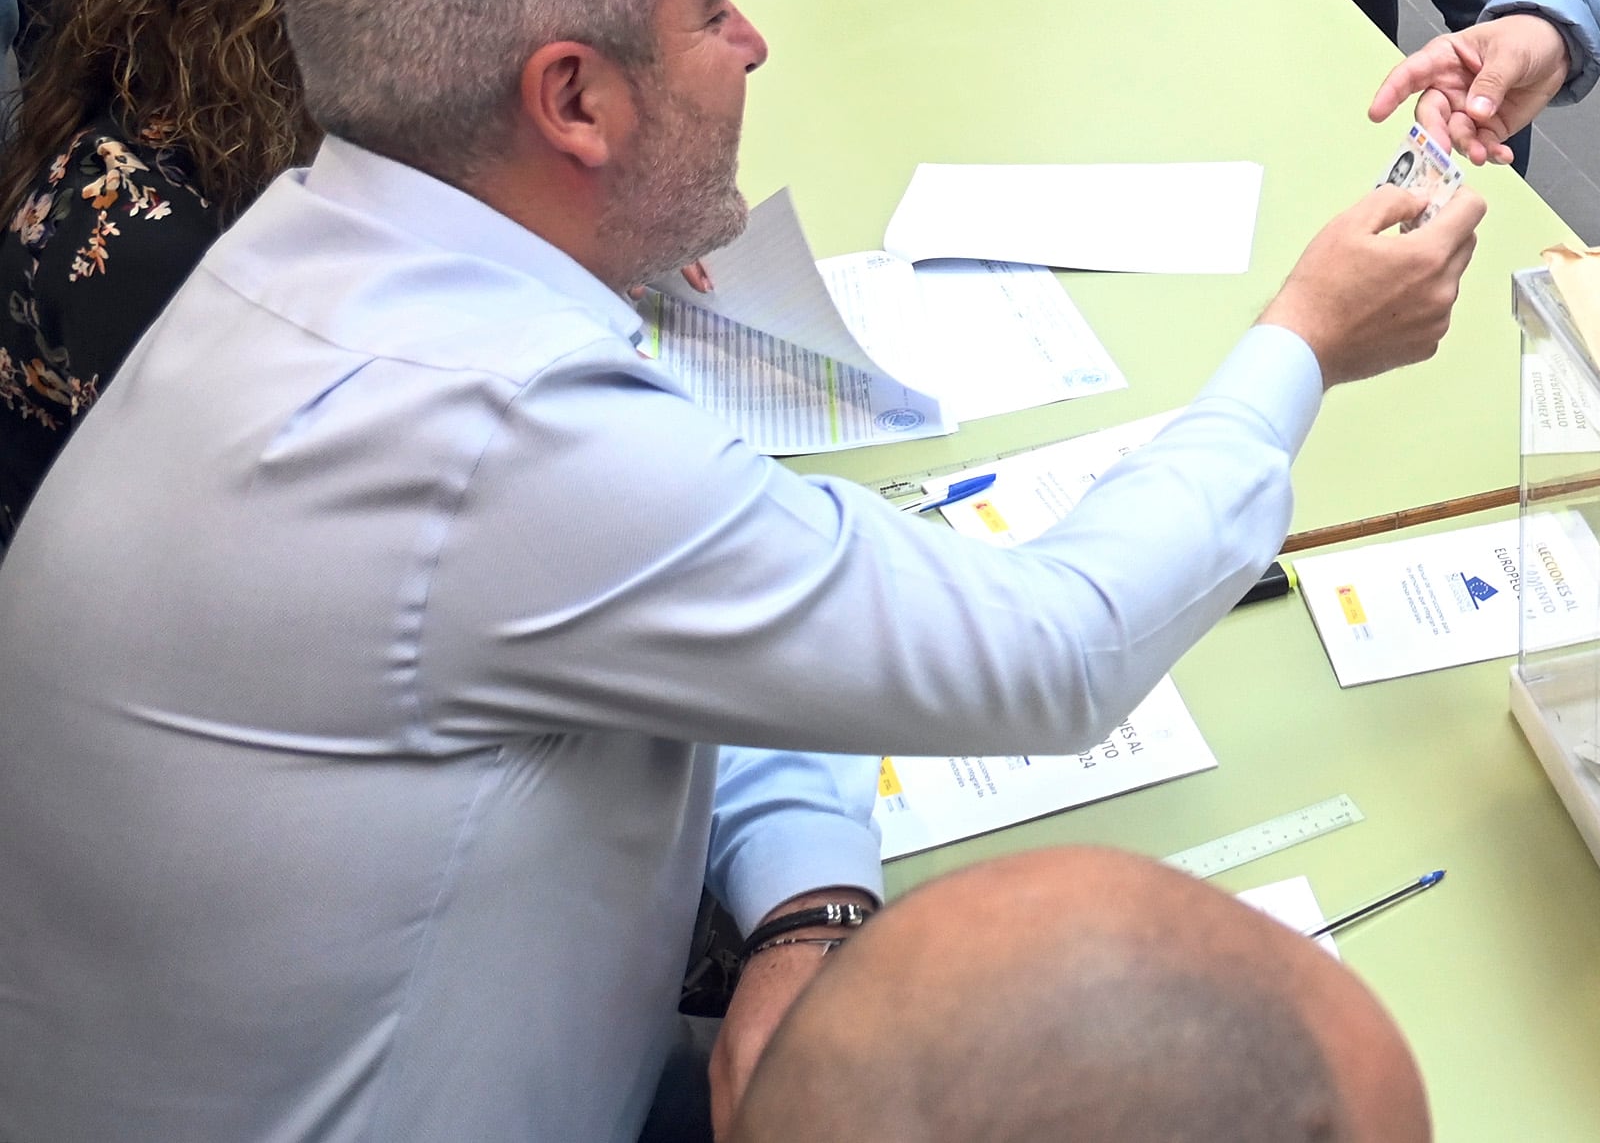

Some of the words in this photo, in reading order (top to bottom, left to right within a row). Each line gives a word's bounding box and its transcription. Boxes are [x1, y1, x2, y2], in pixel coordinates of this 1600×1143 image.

[1535, 541, 1570, 598] ELECCIONES
[1563, 597, 1578, 611] AL
[1126, 737, 1144, 755] AL
